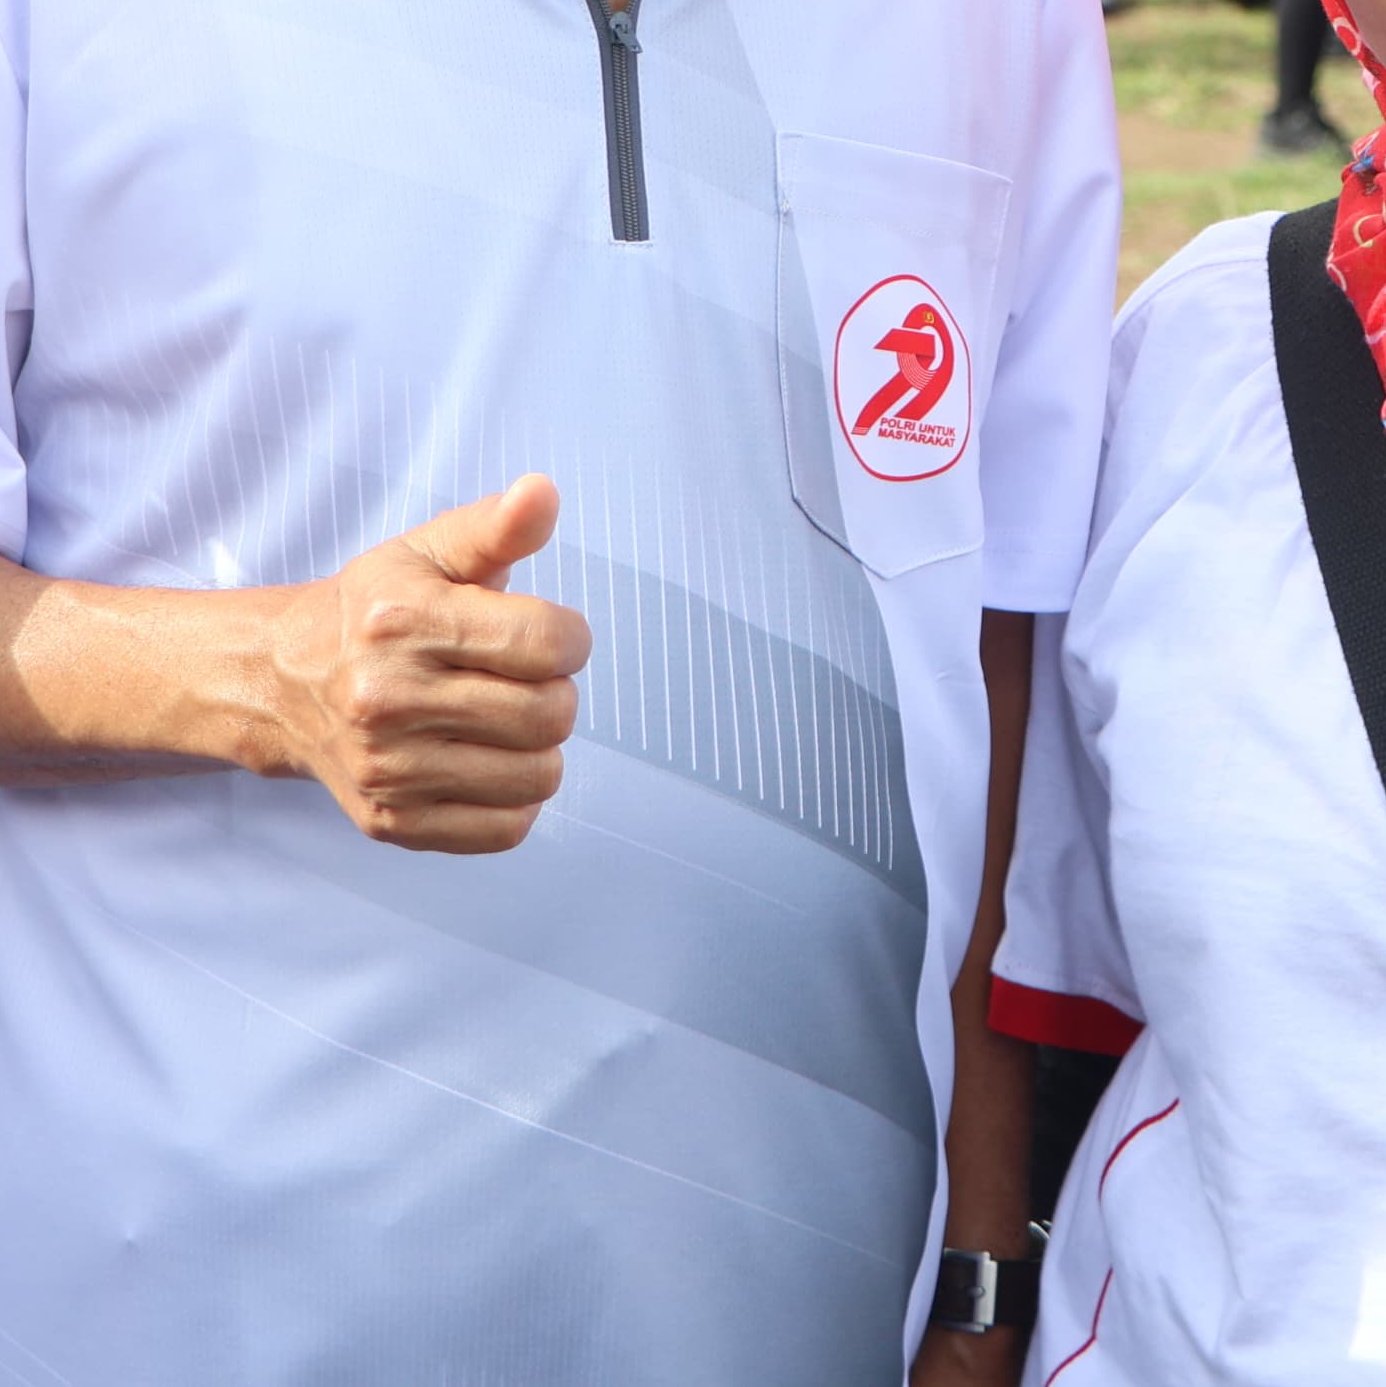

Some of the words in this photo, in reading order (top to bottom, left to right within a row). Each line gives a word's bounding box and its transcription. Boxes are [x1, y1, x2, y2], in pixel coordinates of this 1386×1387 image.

[878, 427, 956, 447] MASYARAKAT
[879, 416, 916, 431] POLRI
[918, 422, 956, 438] UNTUK
